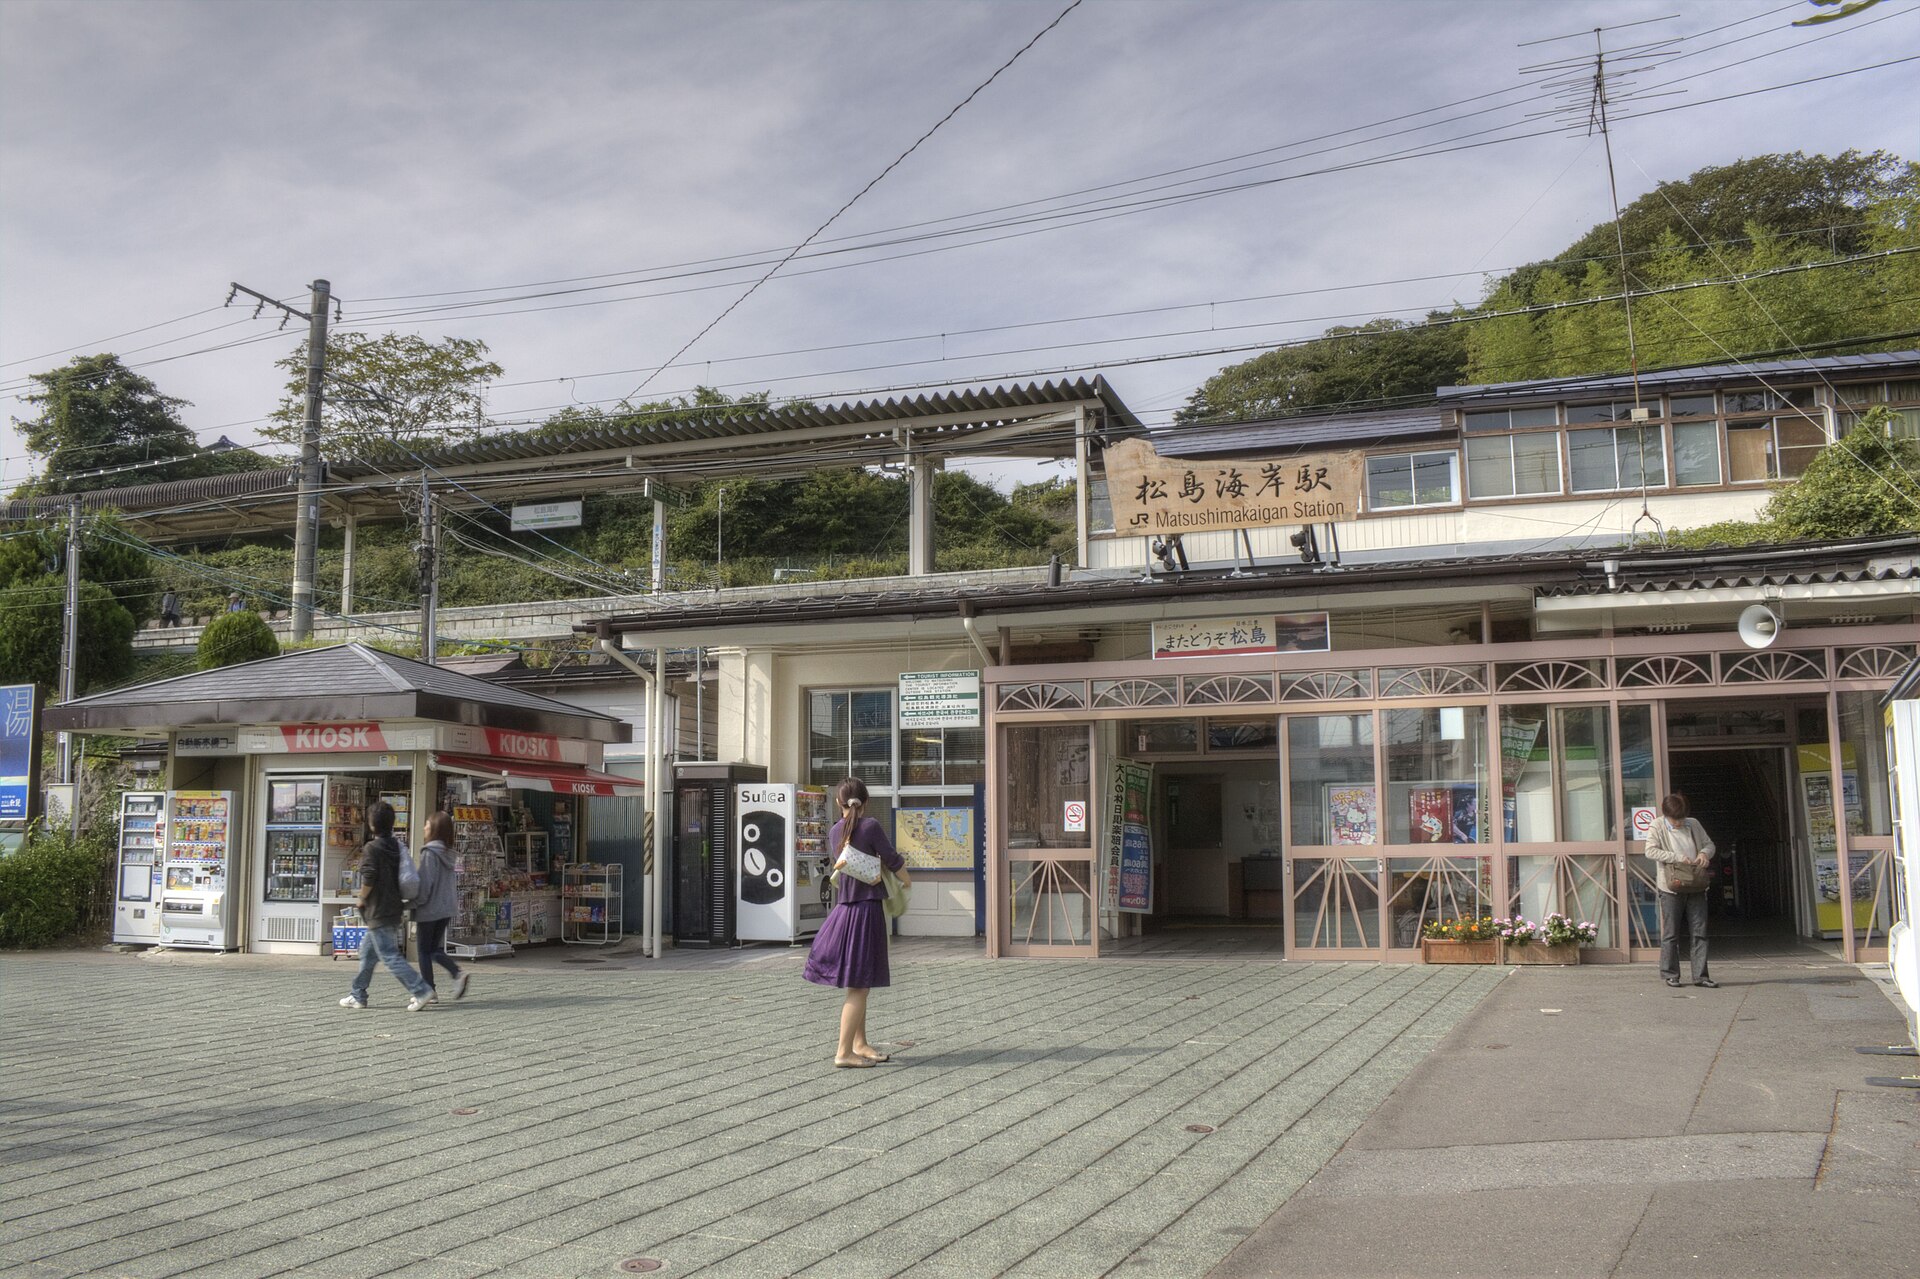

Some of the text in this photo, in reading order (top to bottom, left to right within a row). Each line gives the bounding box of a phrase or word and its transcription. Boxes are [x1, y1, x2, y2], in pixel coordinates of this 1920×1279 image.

[1134, 463, 1332, 505] 松島海岸駅
[1130, 500, 1344, 528] JR Matsushimakaigan Station
[1165, 626, 1267, 649] またどうぞ松島
[5, 689, 31, 737] 湯
[296, 727, 370, 749] KIOSK
[500, 734, 549, 756] KIOSK
[572, 782, 596, 794] KIOSK
[741, 790, 786, 803] Suica
